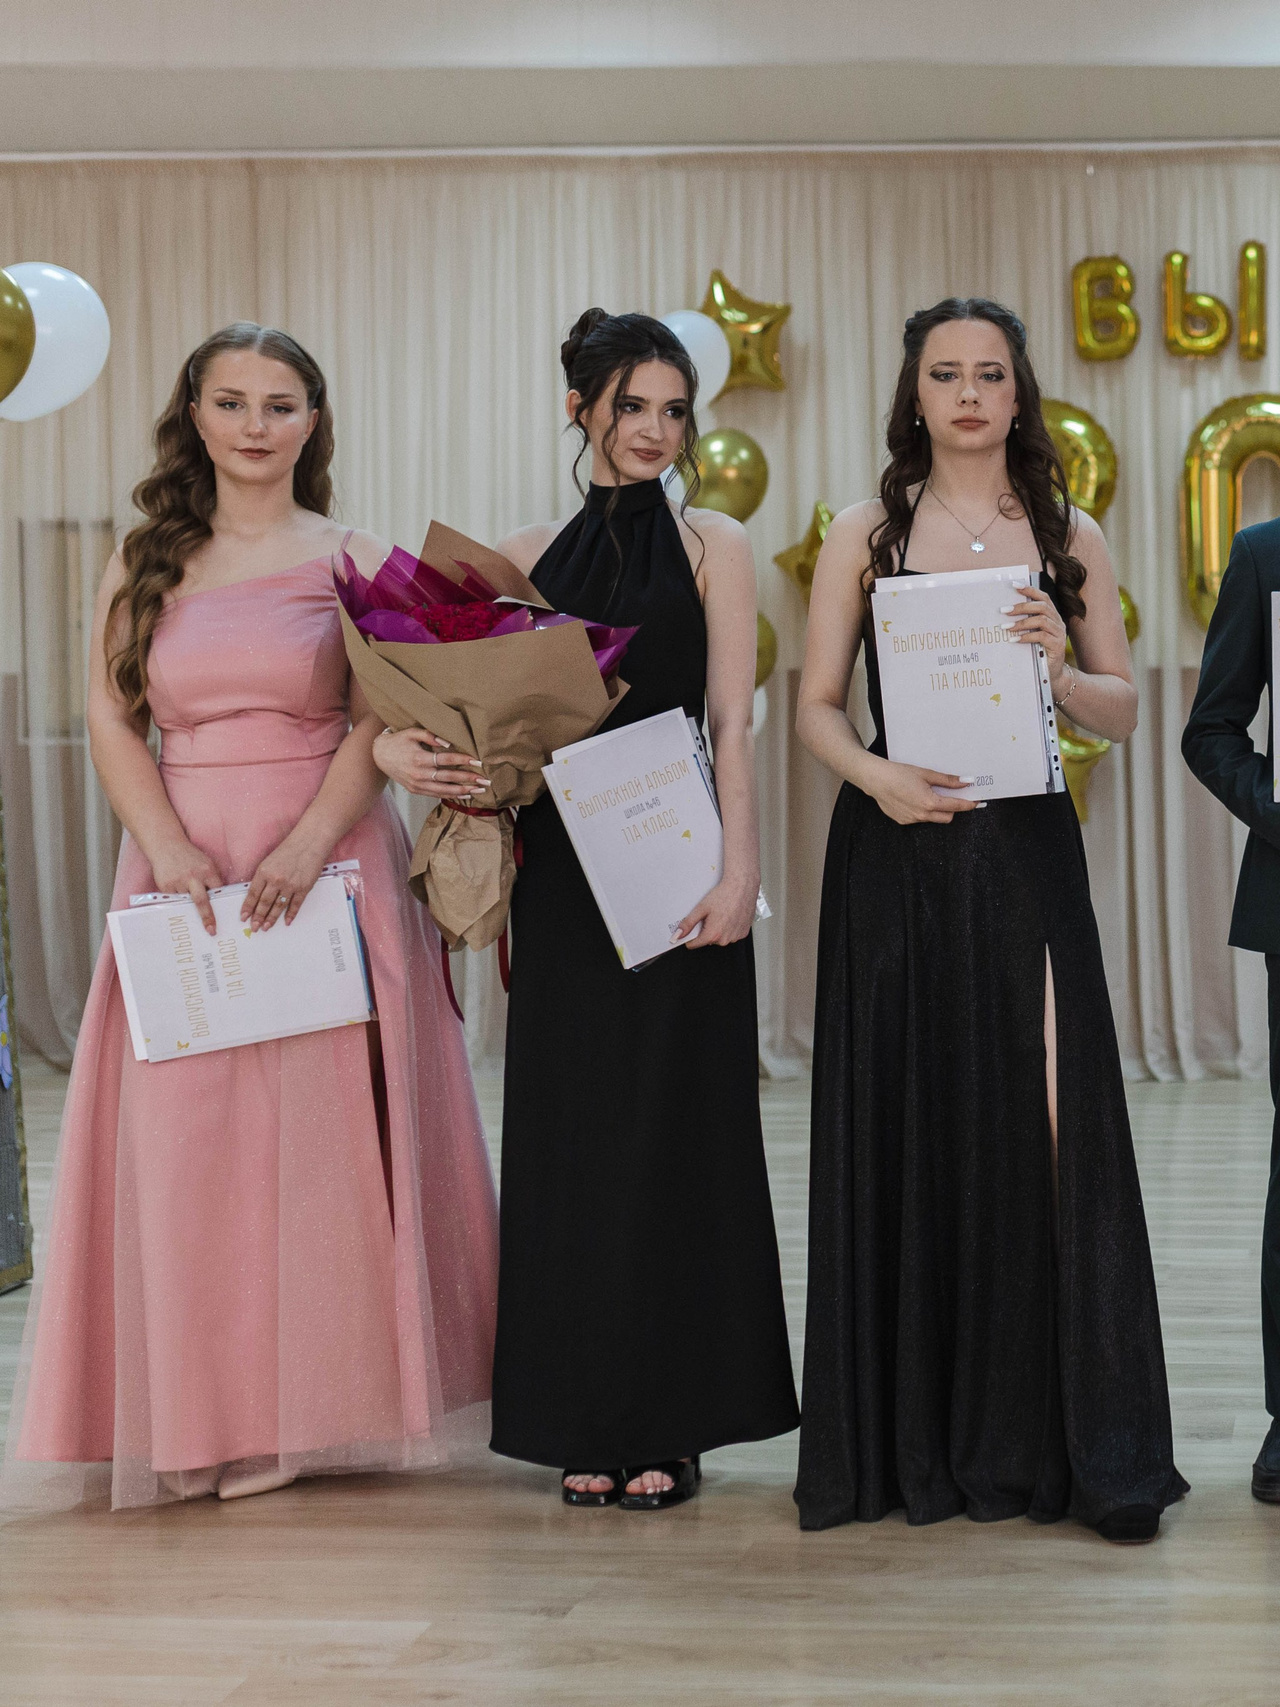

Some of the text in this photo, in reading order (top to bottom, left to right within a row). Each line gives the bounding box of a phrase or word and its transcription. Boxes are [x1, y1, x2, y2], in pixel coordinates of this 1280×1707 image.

[893, 627, 966, 653] ВЫПУСКНОЙ
[938, 655, 962, 666] ШКОЛА
[953, 668, 992, 690] КЛАСС
[577, 760, 690, 818] ВЫПУСКНОЙ АЛЬБОМ
[976, 775, 994, 787] 2026
[624, 803, 646, 819] ШКОЛА
[643, 809, 679, 836] КЛАСС
[218, 938, 243, 976] КЛАСС
[169, 915, 209, 1038] ВЫПУСКНОЙ АЛЬБОМ
